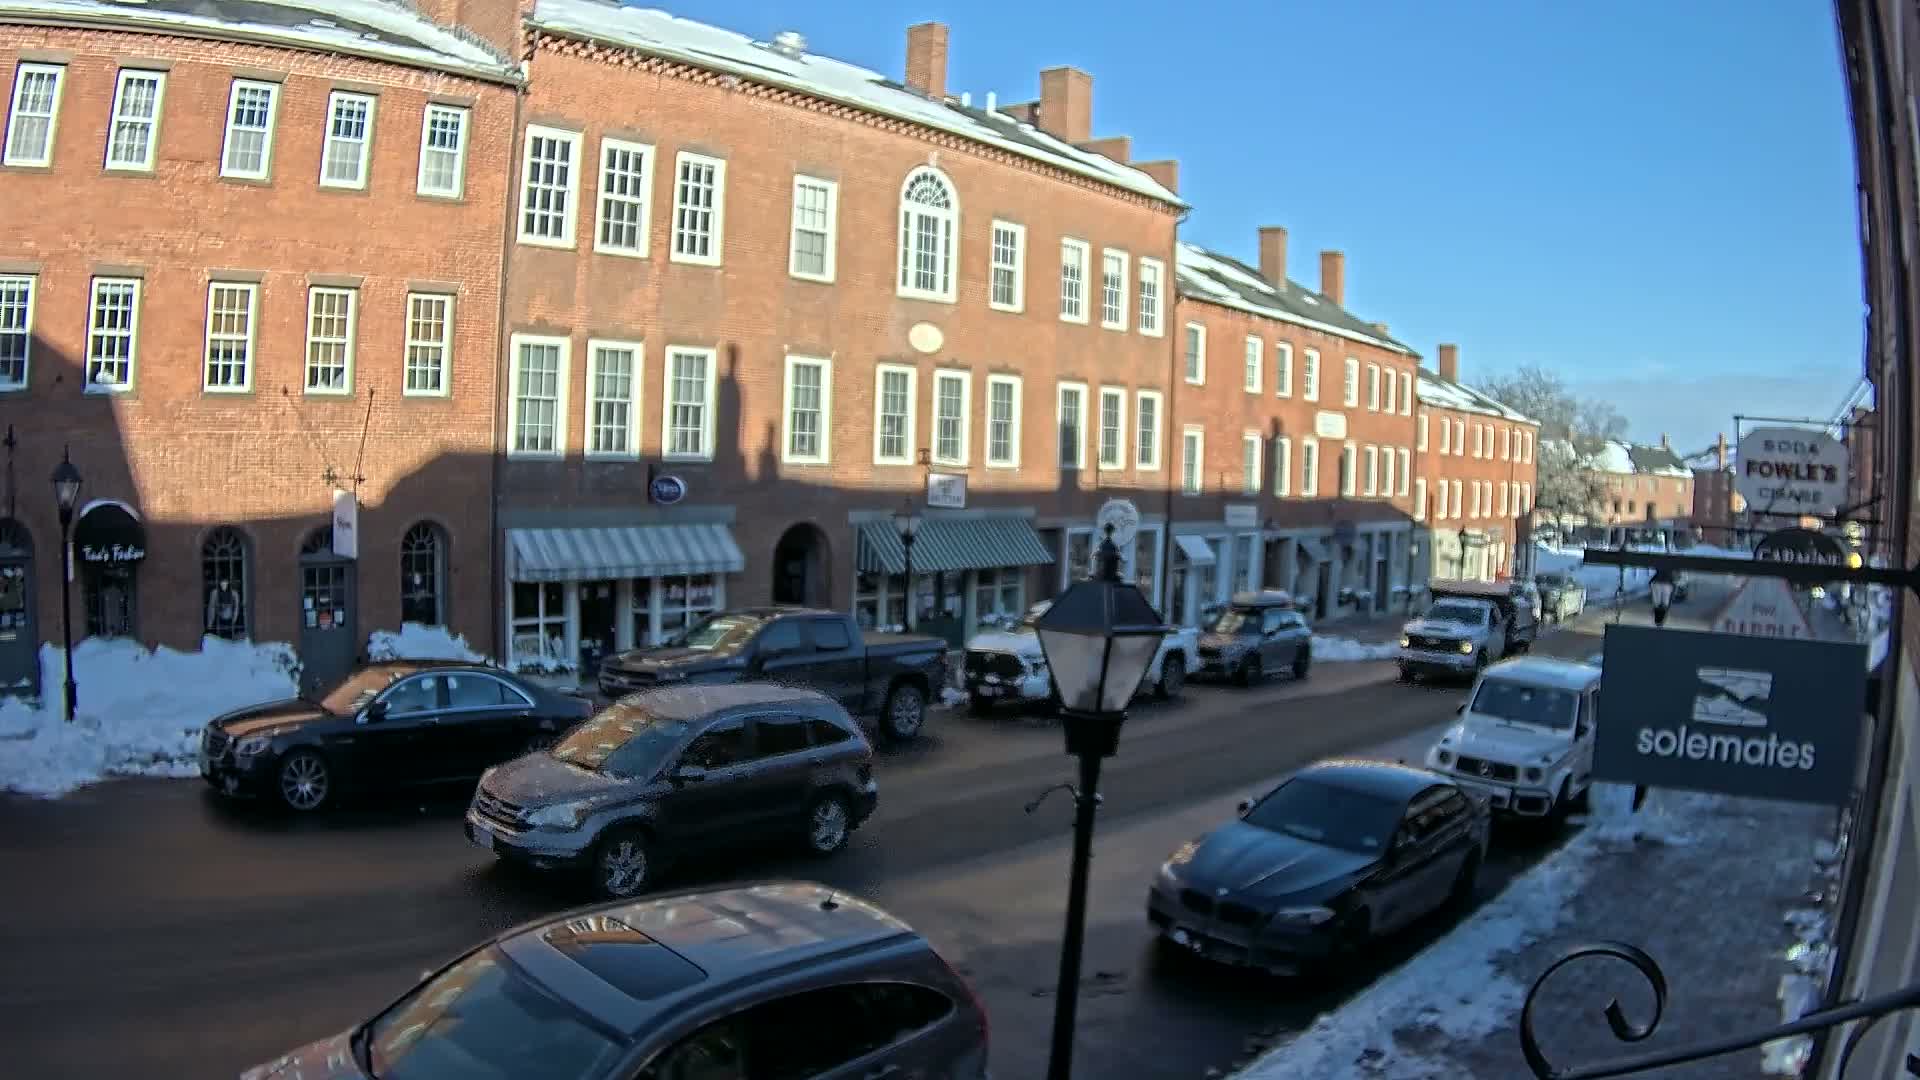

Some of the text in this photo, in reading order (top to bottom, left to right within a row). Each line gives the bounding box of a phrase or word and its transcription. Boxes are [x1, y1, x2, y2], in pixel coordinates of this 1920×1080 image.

[1763, 439, 1820, 456] SODA
[1746, 459, 1837, 483] FOWLE'S
[1637, 725, 1816, 770] solemates
